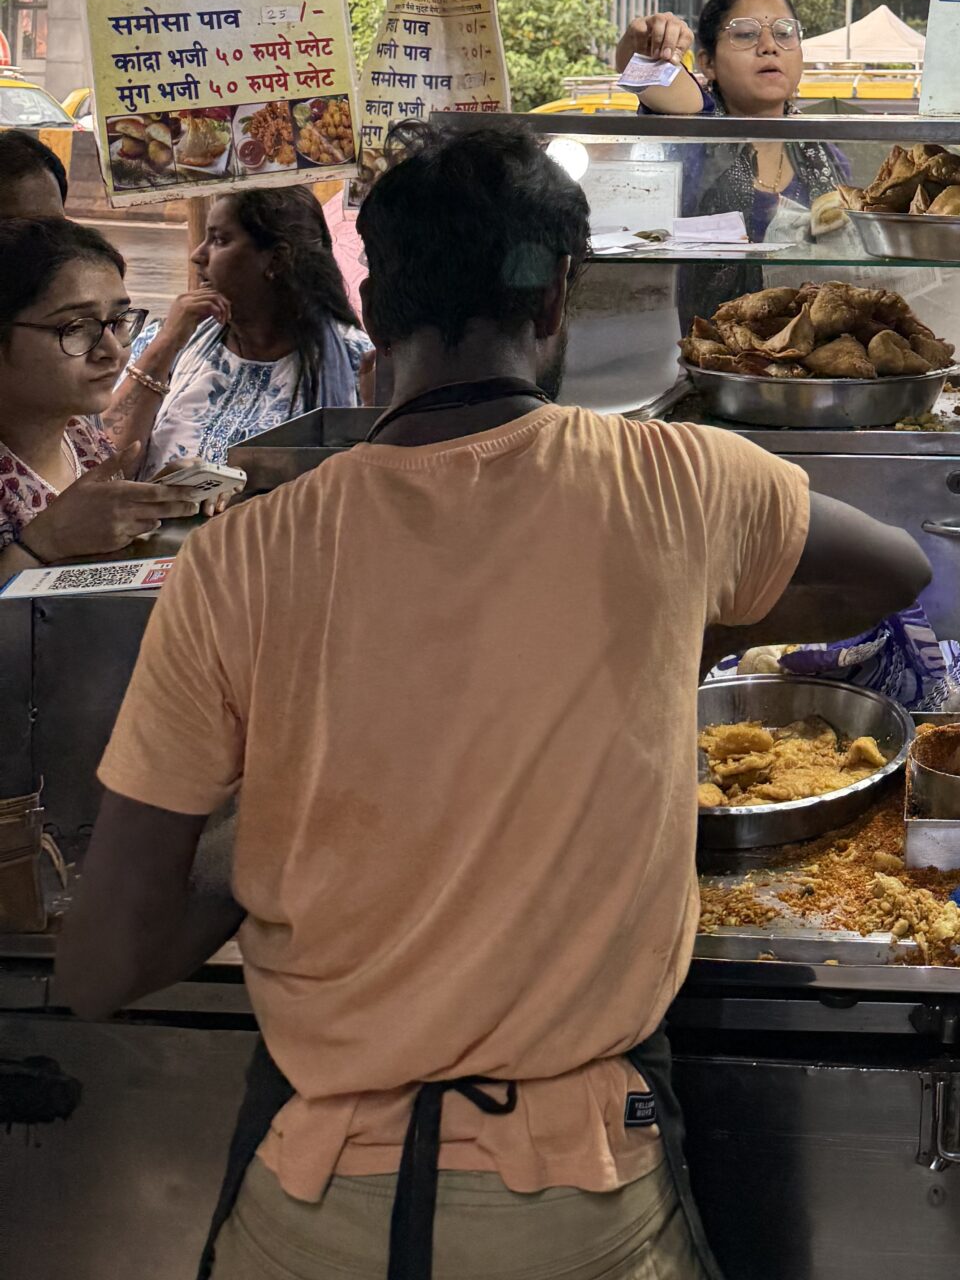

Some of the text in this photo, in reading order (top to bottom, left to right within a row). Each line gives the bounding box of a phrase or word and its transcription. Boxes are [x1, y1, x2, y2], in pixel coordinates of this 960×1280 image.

[108, 6, 190, 36] समोसा
[196, 8, 241, 30] पाव
[402, 18, 430, 36] पाव
[168, 40, 208, 69] भजी
[215, 46, 243, 67] ५०
[250, 33, 293, 62] रुपये
[295, 31, 335, 60] प्लेट
[403, 45, 432, 62] पाव
[116, 62, 336, 112] मुंग भजी ५० रुपये प्लेट
[370, 66, 418, 89] समोसा
[422, 74, 453, 90] पाव
[398, 96, 425, 119] भजी
